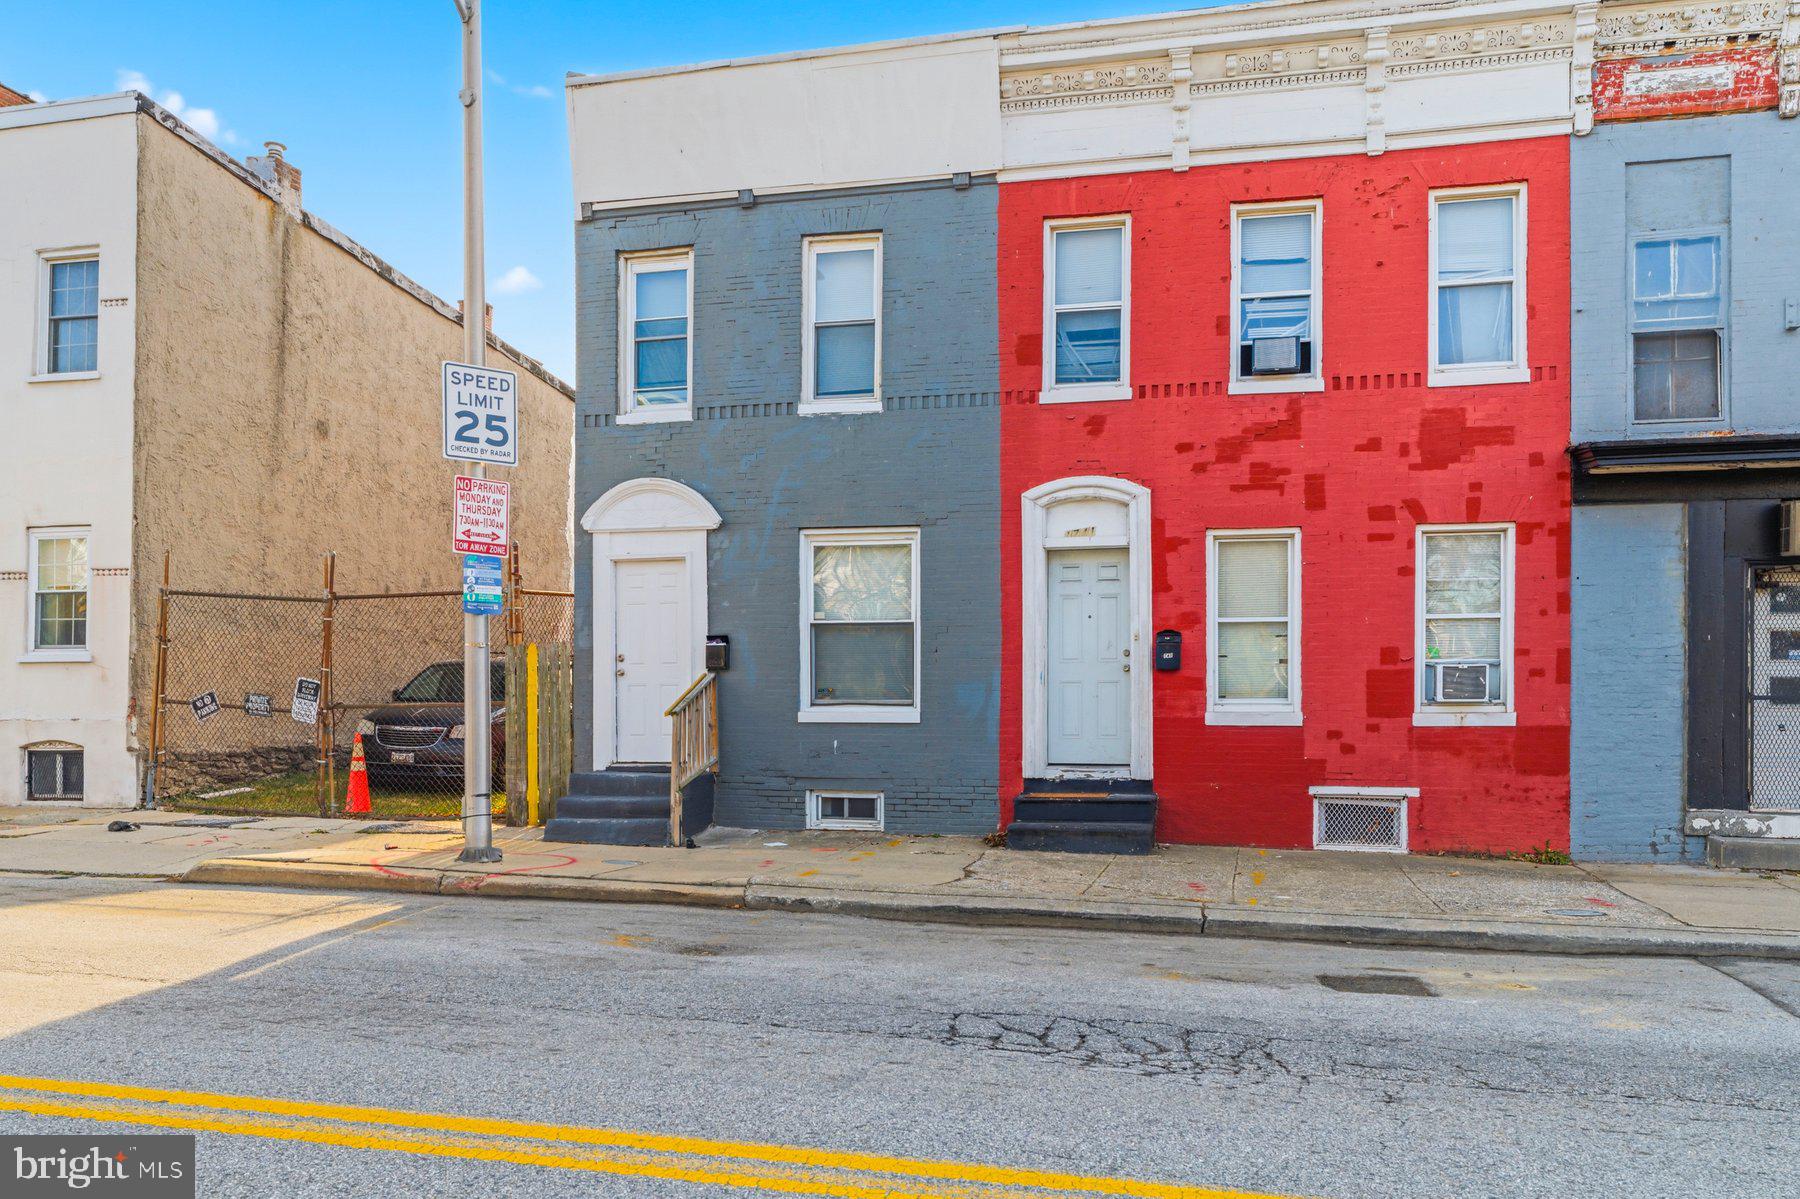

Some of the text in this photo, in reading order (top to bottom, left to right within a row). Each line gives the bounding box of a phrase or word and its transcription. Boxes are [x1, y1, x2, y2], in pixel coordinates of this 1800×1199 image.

[451, 371, 510, 392] SPEED
[457, 391, 503, 410] LIMIT
[454, 410, 509, 447] 25
[450, 444, 478, 454] CHECKED
[490, 450, 511, 458] RADAR
[457, 479, 506, 495] NO PARKING
[460, 492, 504, 507] MONDAY AND
[462, 503, 501, 517] THURSDAY
[455, 541, 506, 555] TOW AWAY ZONE
